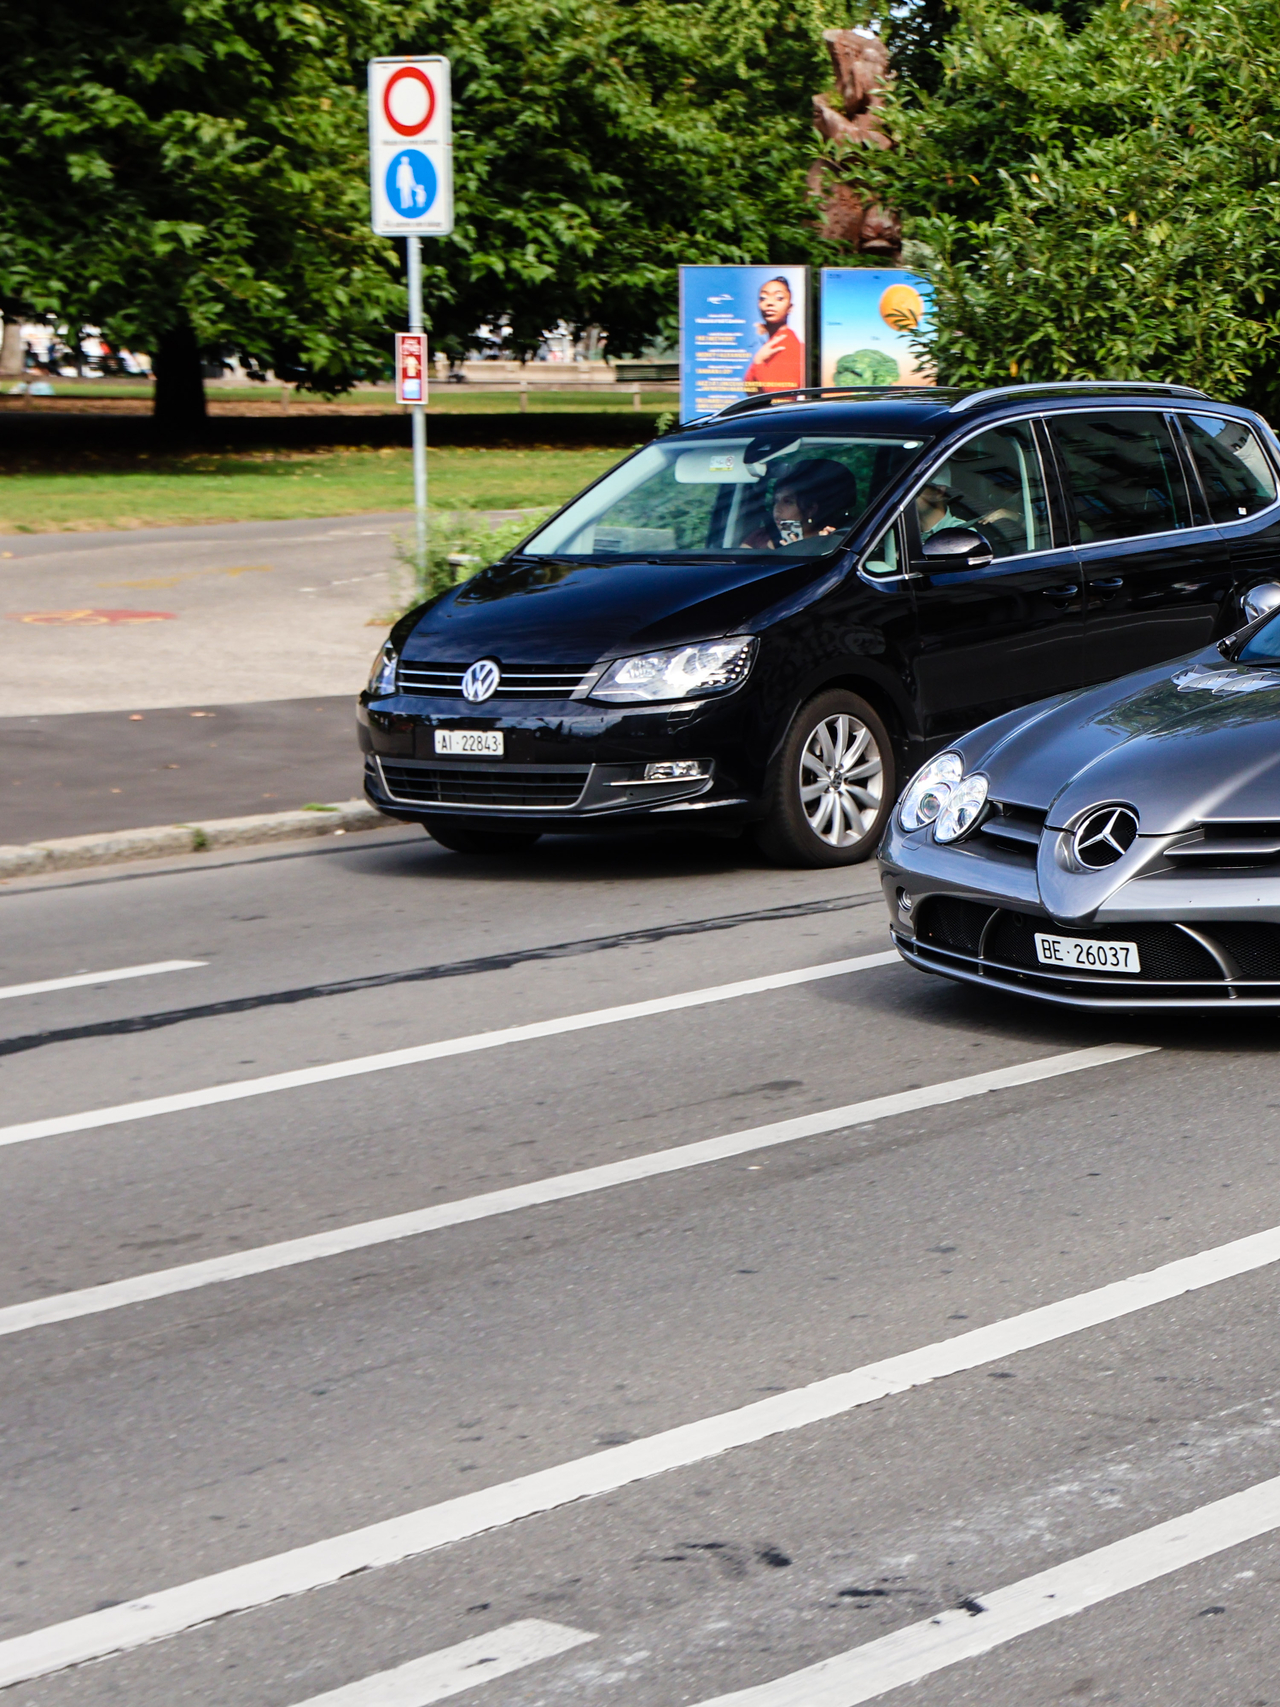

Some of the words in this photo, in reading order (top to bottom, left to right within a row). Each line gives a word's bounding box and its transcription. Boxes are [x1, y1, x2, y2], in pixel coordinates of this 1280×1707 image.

[461, 735, 499, 752] 22843
[1041, 938, 1064, 961] BE
[1073, 943, 1130, 968] 26037
